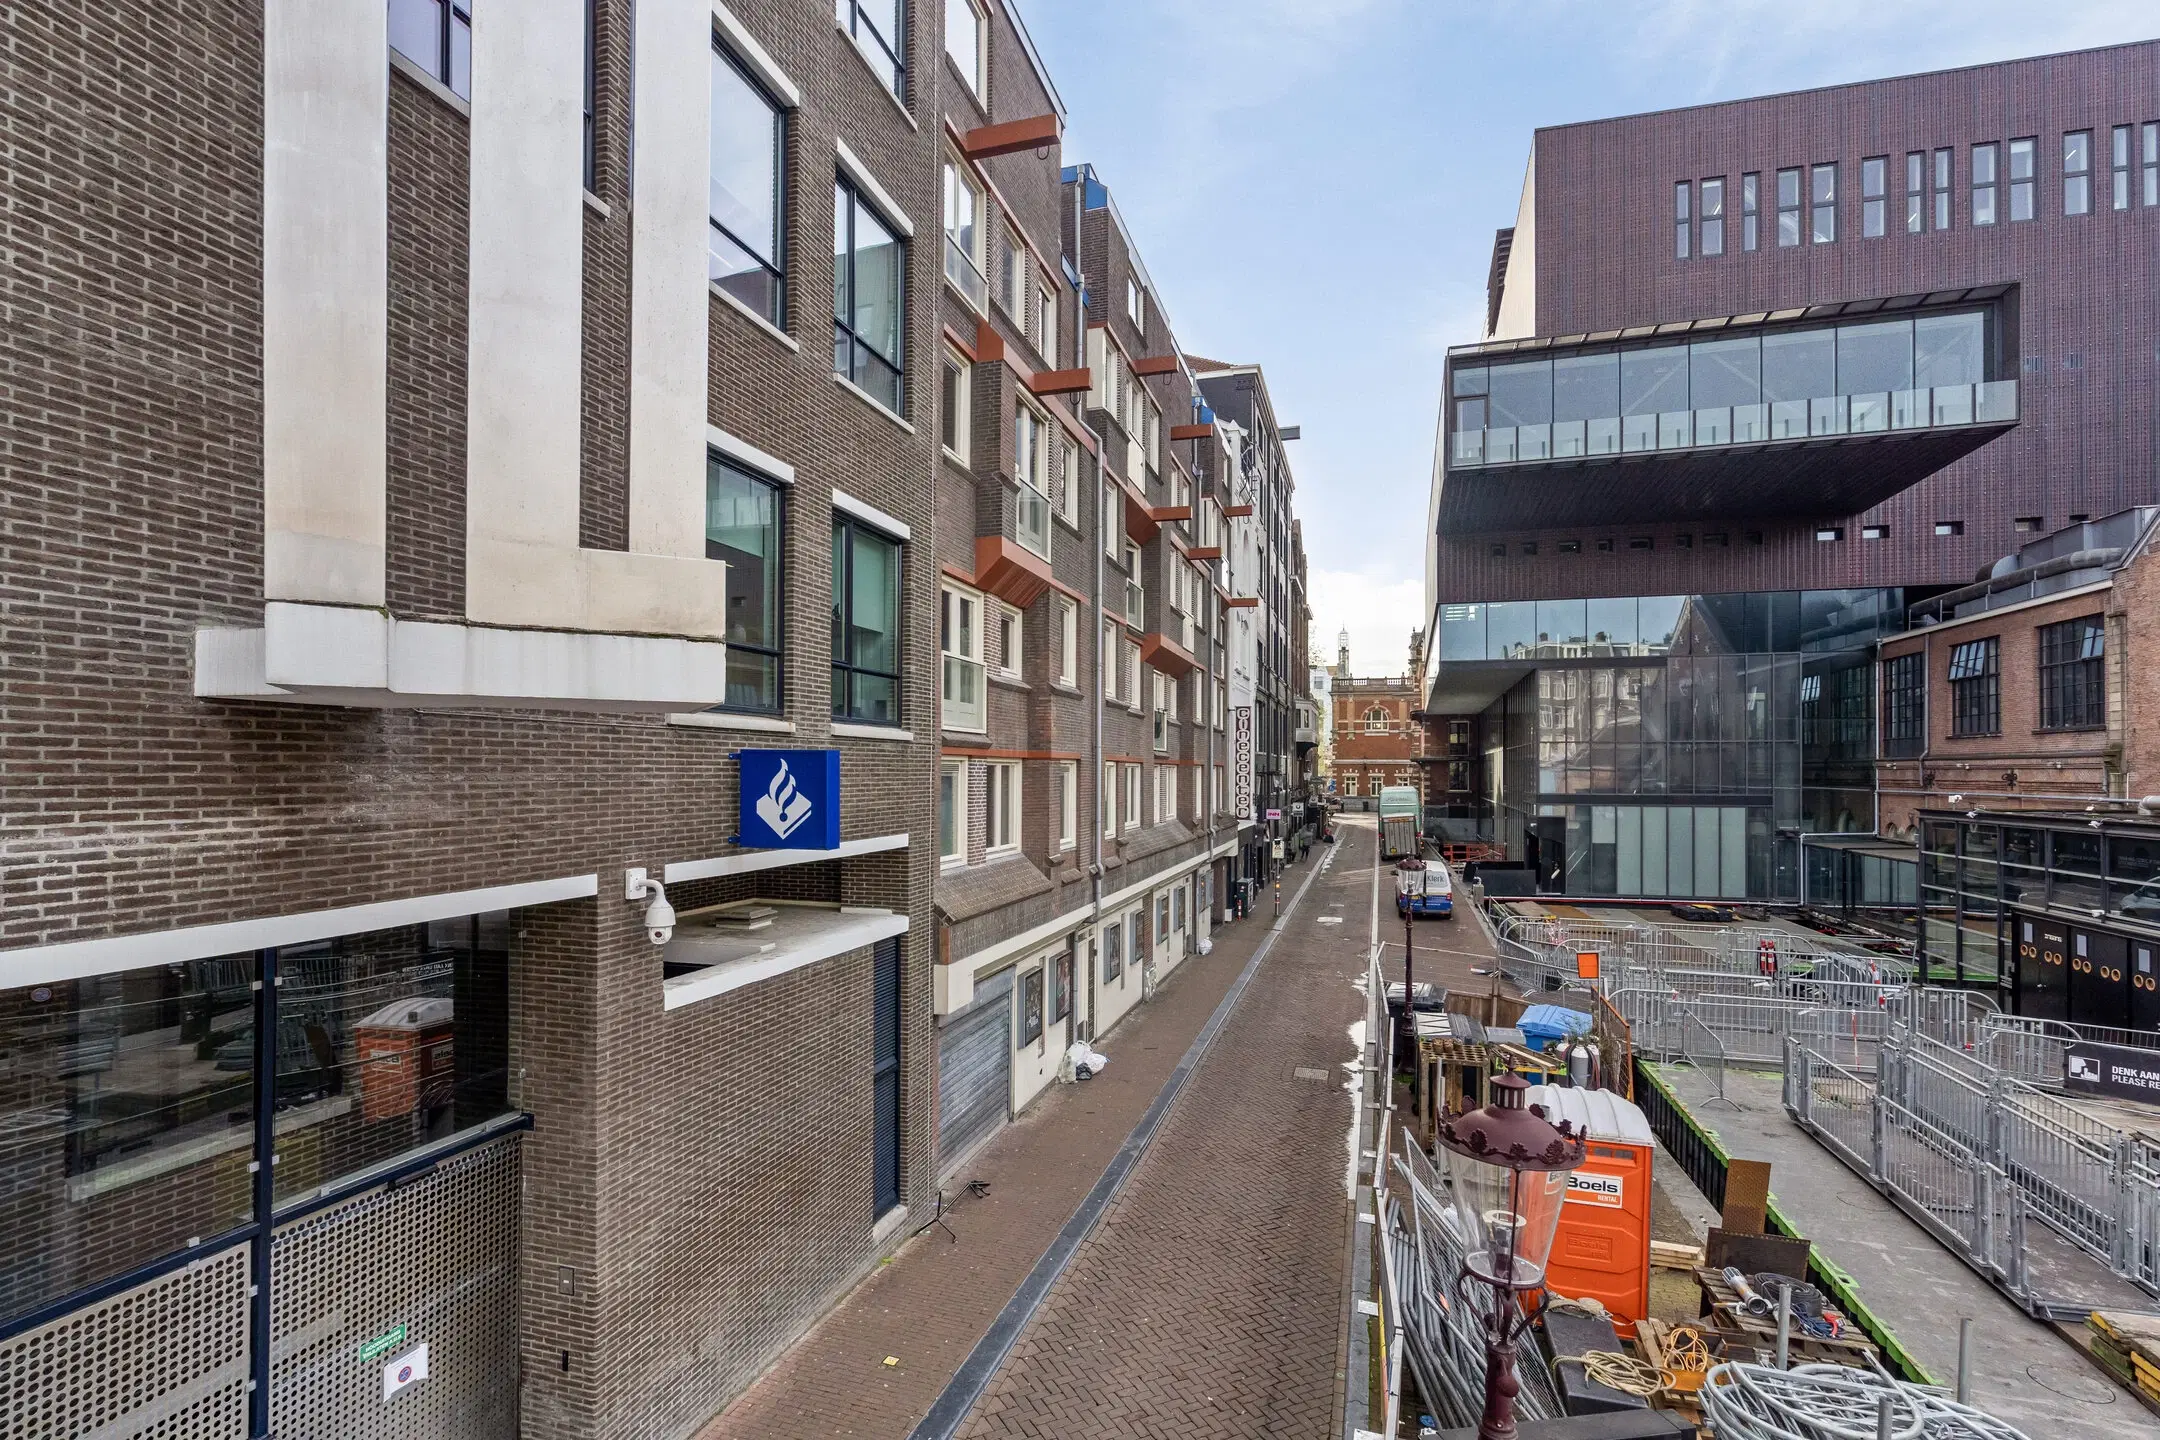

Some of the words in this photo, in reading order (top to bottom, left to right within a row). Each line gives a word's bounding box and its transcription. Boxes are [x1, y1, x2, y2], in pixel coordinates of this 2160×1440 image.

[1236, 707, 1250, 819] cinecenter
[1426, 875, 1444, 883] Klerk
[2112, 1065, 2138, 1077] DENK
[2139, 1070, 2160, 1081] AAN
[2112, 1074, 2147, 1088] PLEASE
[1567, 1176, 1618, 1193] Boels
[1597, 1194, 1618, 1203] RENTAL
